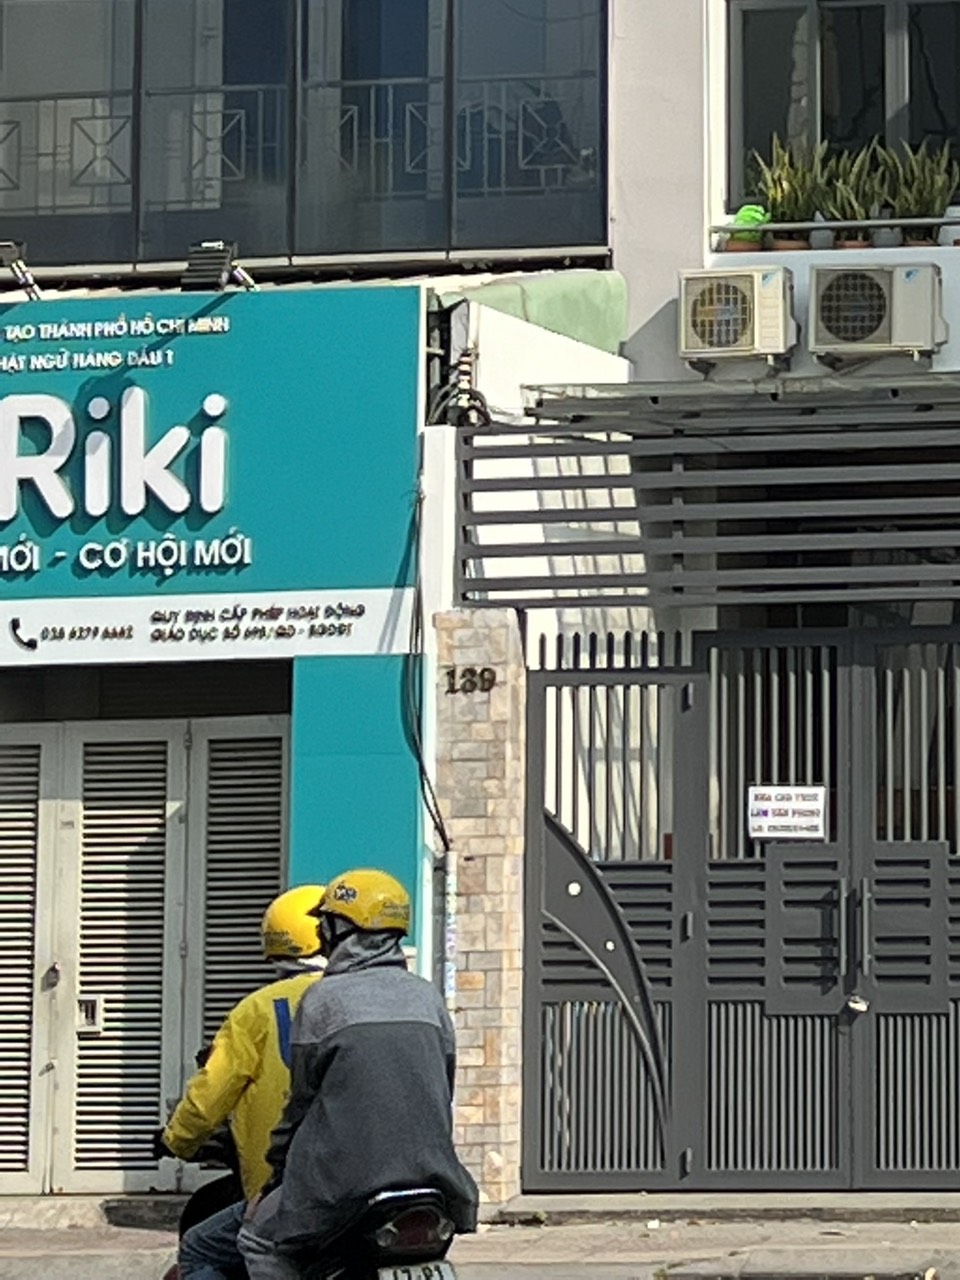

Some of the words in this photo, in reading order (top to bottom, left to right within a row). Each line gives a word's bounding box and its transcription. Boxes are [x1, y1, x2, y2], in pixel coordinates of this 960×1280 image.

[166, 349, 174, 365] 1
[0, 386, 228, 520] Riki
[79, 537, 130, 569] CƠ
[137, 532, 187, 576] HỘI
[194, 526, 252, 566] MỚI
